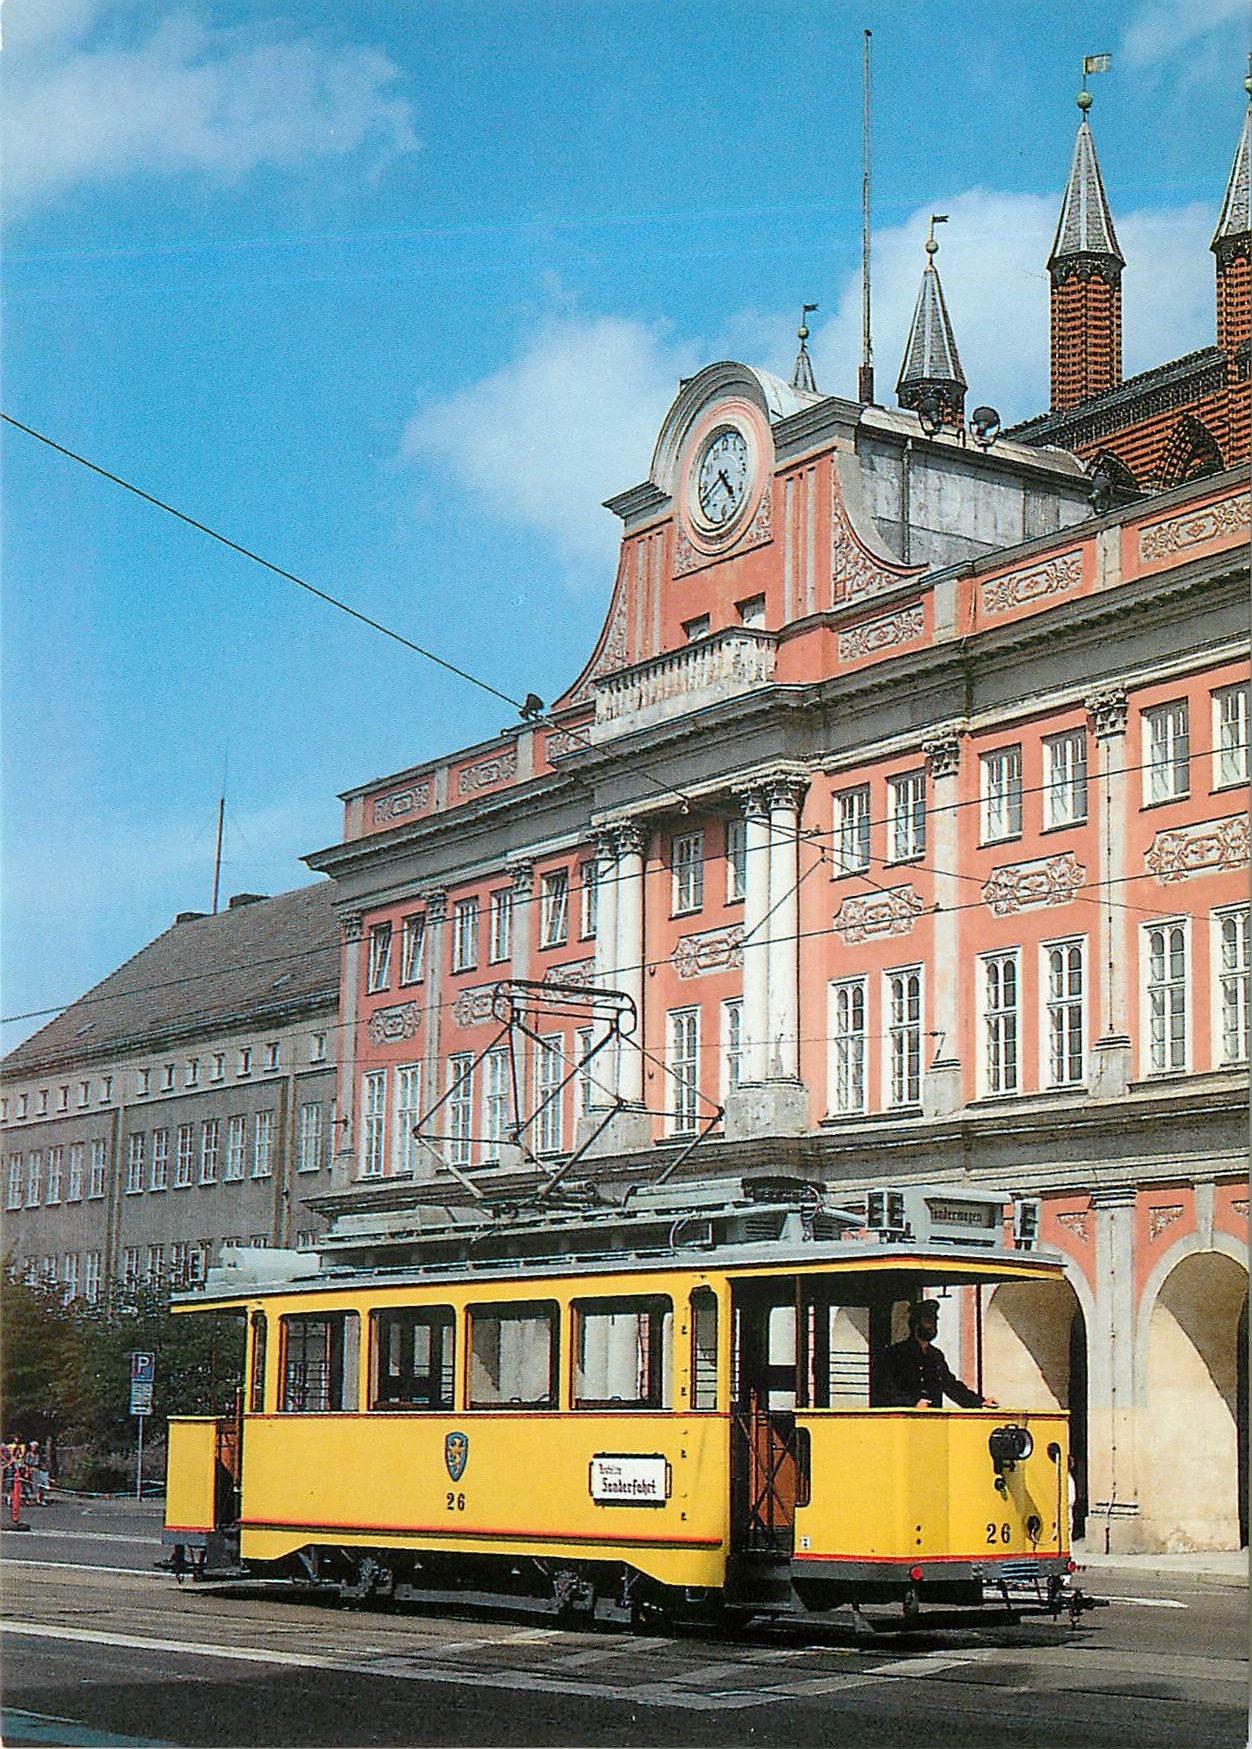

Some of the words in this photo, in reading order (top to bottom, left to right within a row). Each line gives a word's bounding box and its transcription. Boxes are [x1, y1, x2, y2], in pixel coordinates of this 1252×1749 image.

[138, 1356, 150, 1374] P
[602, 1477, 656, 1496] Sonderfahrt
[446, 1492, 465, 1511] 26
[986, 1523, 1011, 1544] 26
